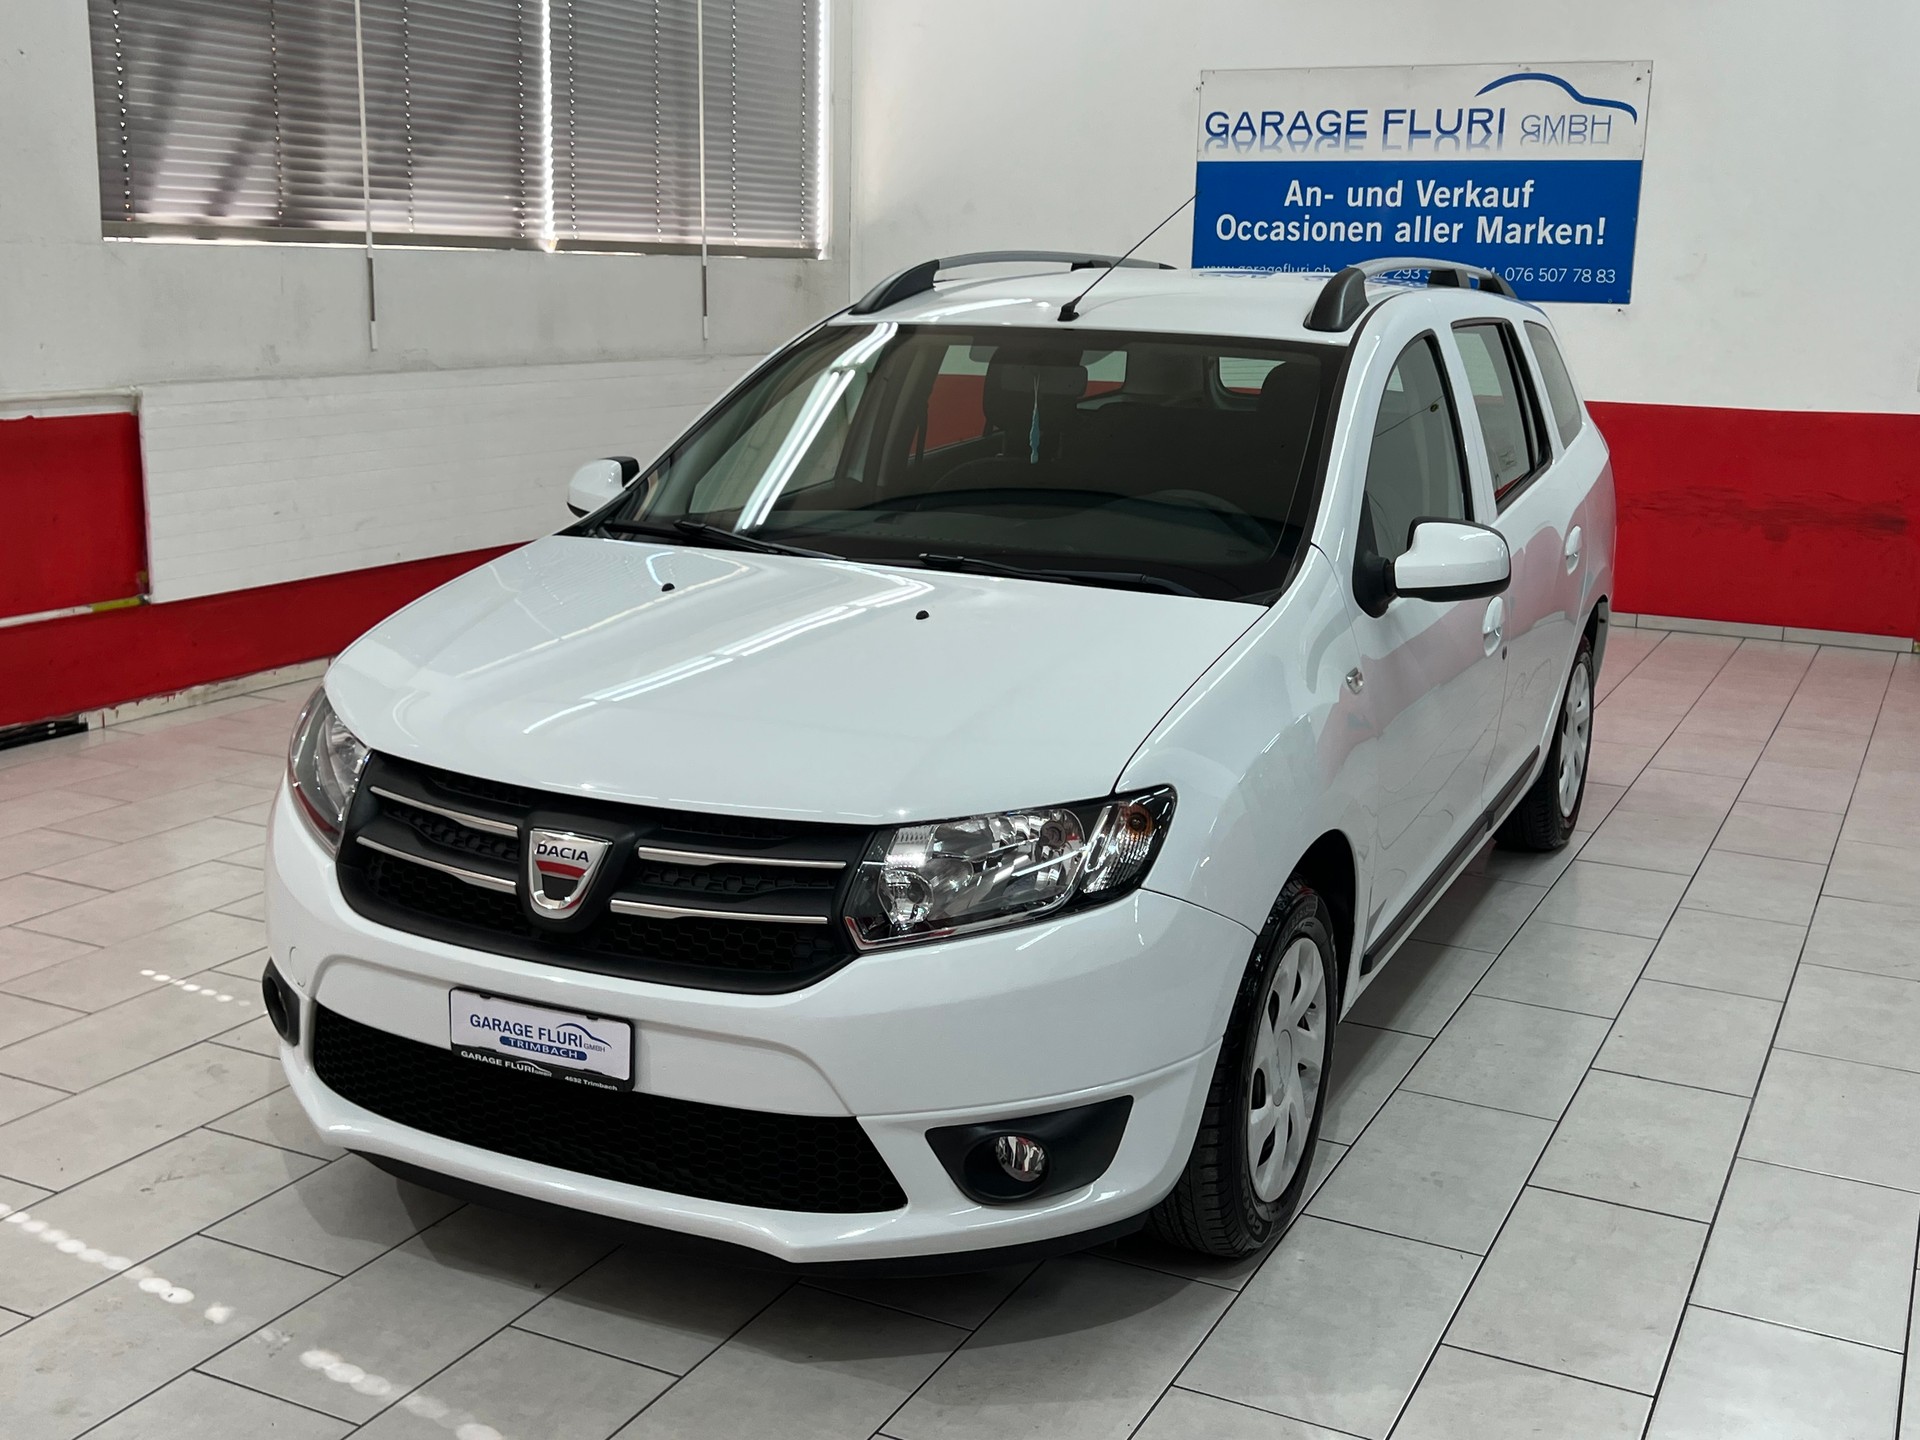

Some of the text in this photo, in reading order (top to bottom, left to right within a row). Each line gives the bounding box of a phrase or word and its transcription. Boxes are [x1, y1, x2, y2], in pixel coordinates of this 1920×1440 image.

[1205, 108, 1613, 138] GARAGE FLURI GMBH
[1284, 179, 1535, 209] An- und Verkauf
[1215, 213, 1607, 246] Occasionen aller Marken!
[1504, 267, 1534, 282] 076
[1538, 268, 1568, 283] 507
[1573, 268, 1593, 283] 78
[1595, 269, 1616, 284] 83
[536, 843, 590, 863] DACIA
[470, 1013, 534, 1039] GARAGE
[538, 1027, 583, 1048] FLURI
[461, 1050, 503, 1067] GARAGE
[505, 1060, 535, 1074] FLURI
[509, 1038, 578, 1059] TRIMBACH
